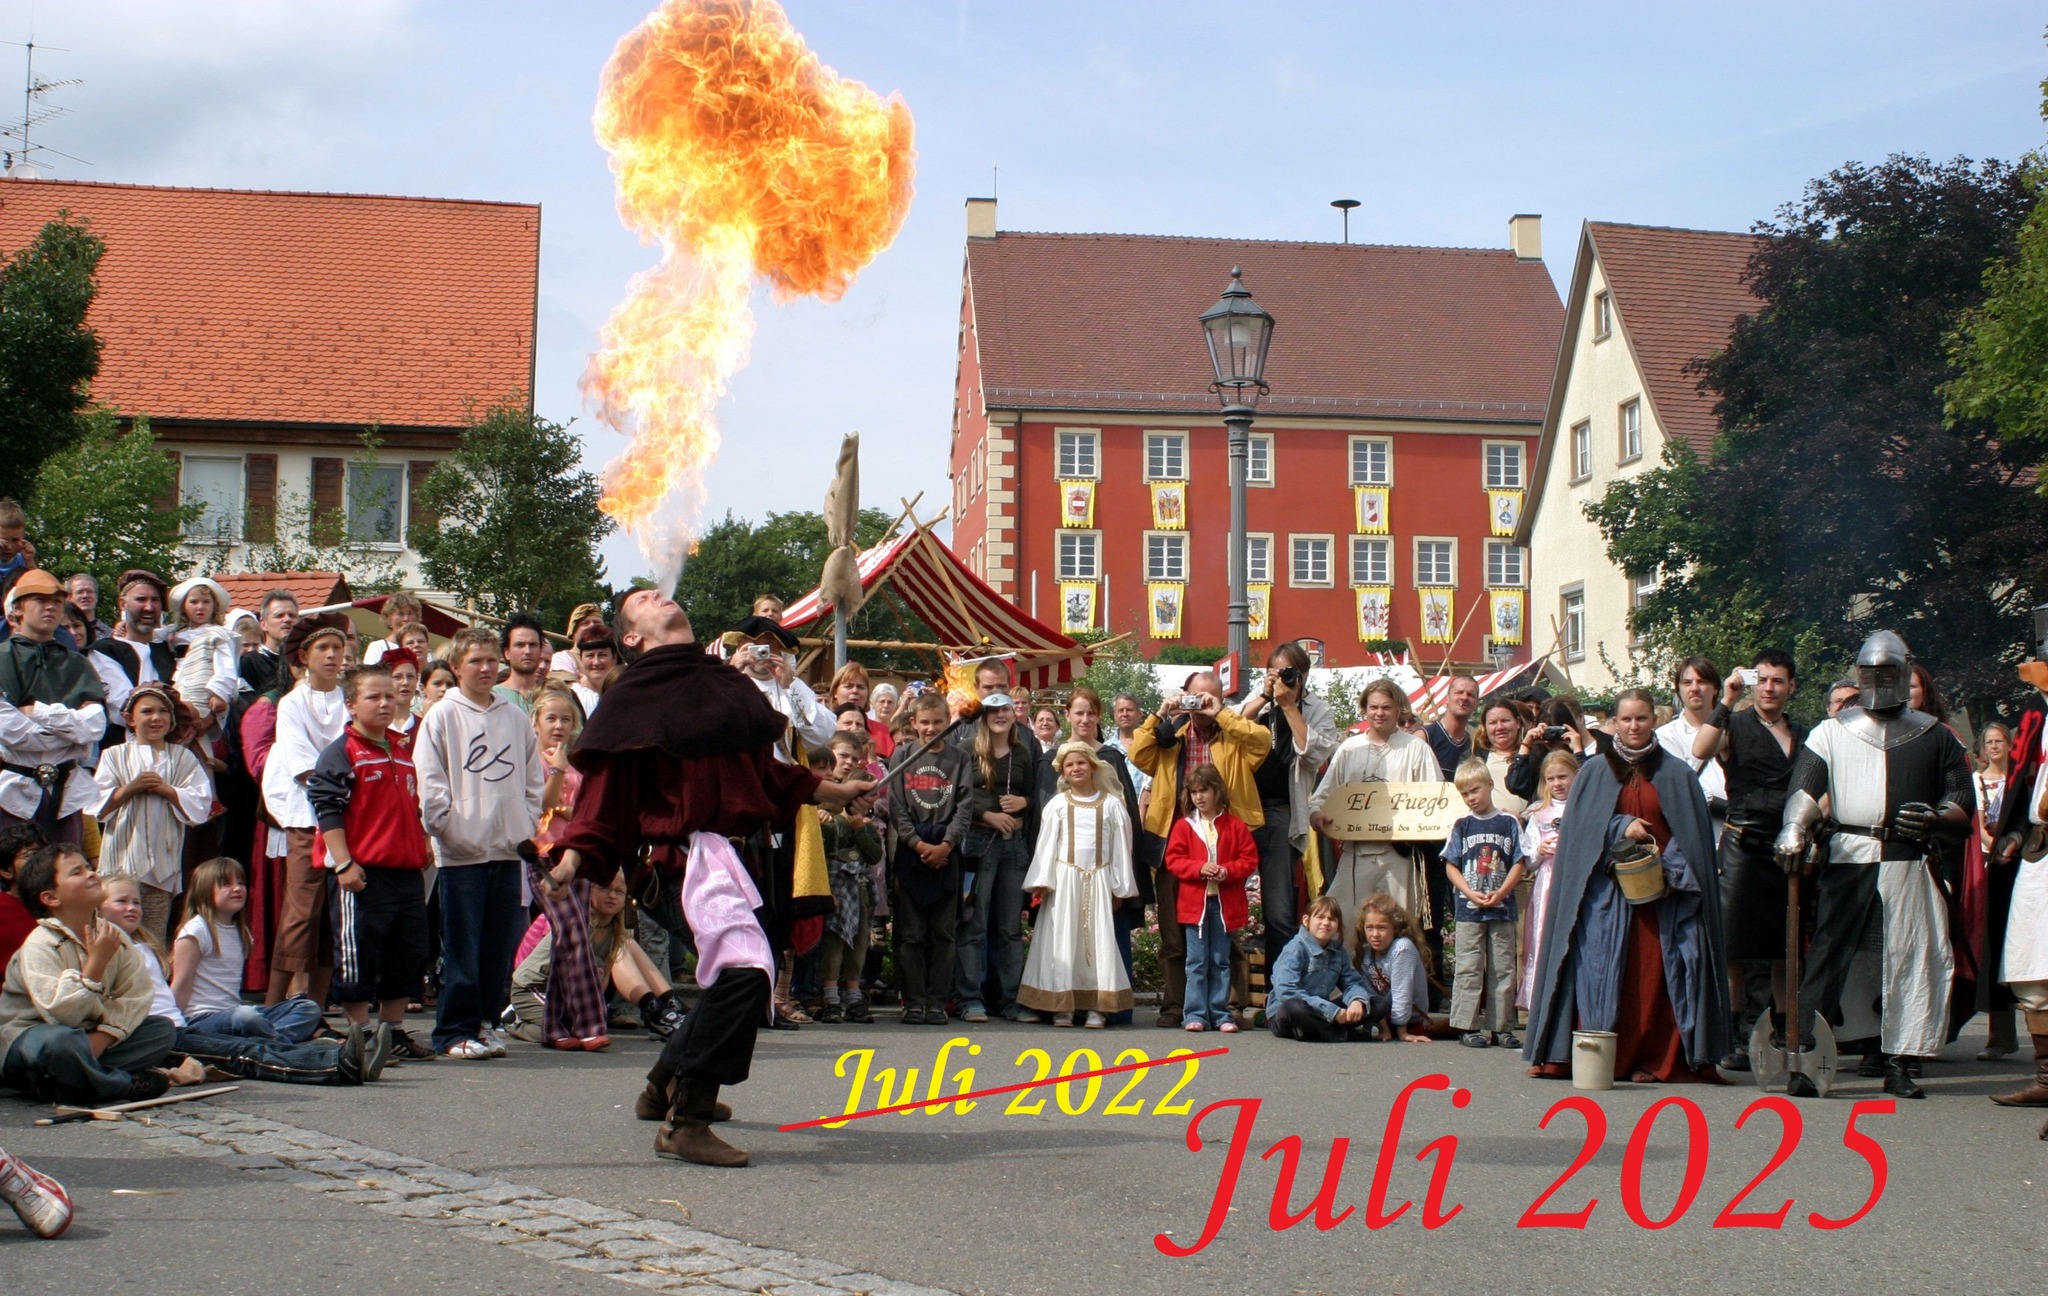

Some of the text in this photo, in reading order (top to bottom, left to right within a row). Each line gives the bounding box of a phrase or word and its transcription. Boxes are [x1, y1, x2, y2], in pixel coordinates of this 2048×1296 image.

[1347, 790, 1449, 817] El Fuego
[1347, 823, 1362, 832] Die
[1368, 823, 1393, 834] Magie
[1398, 823, 1410, 832] des
